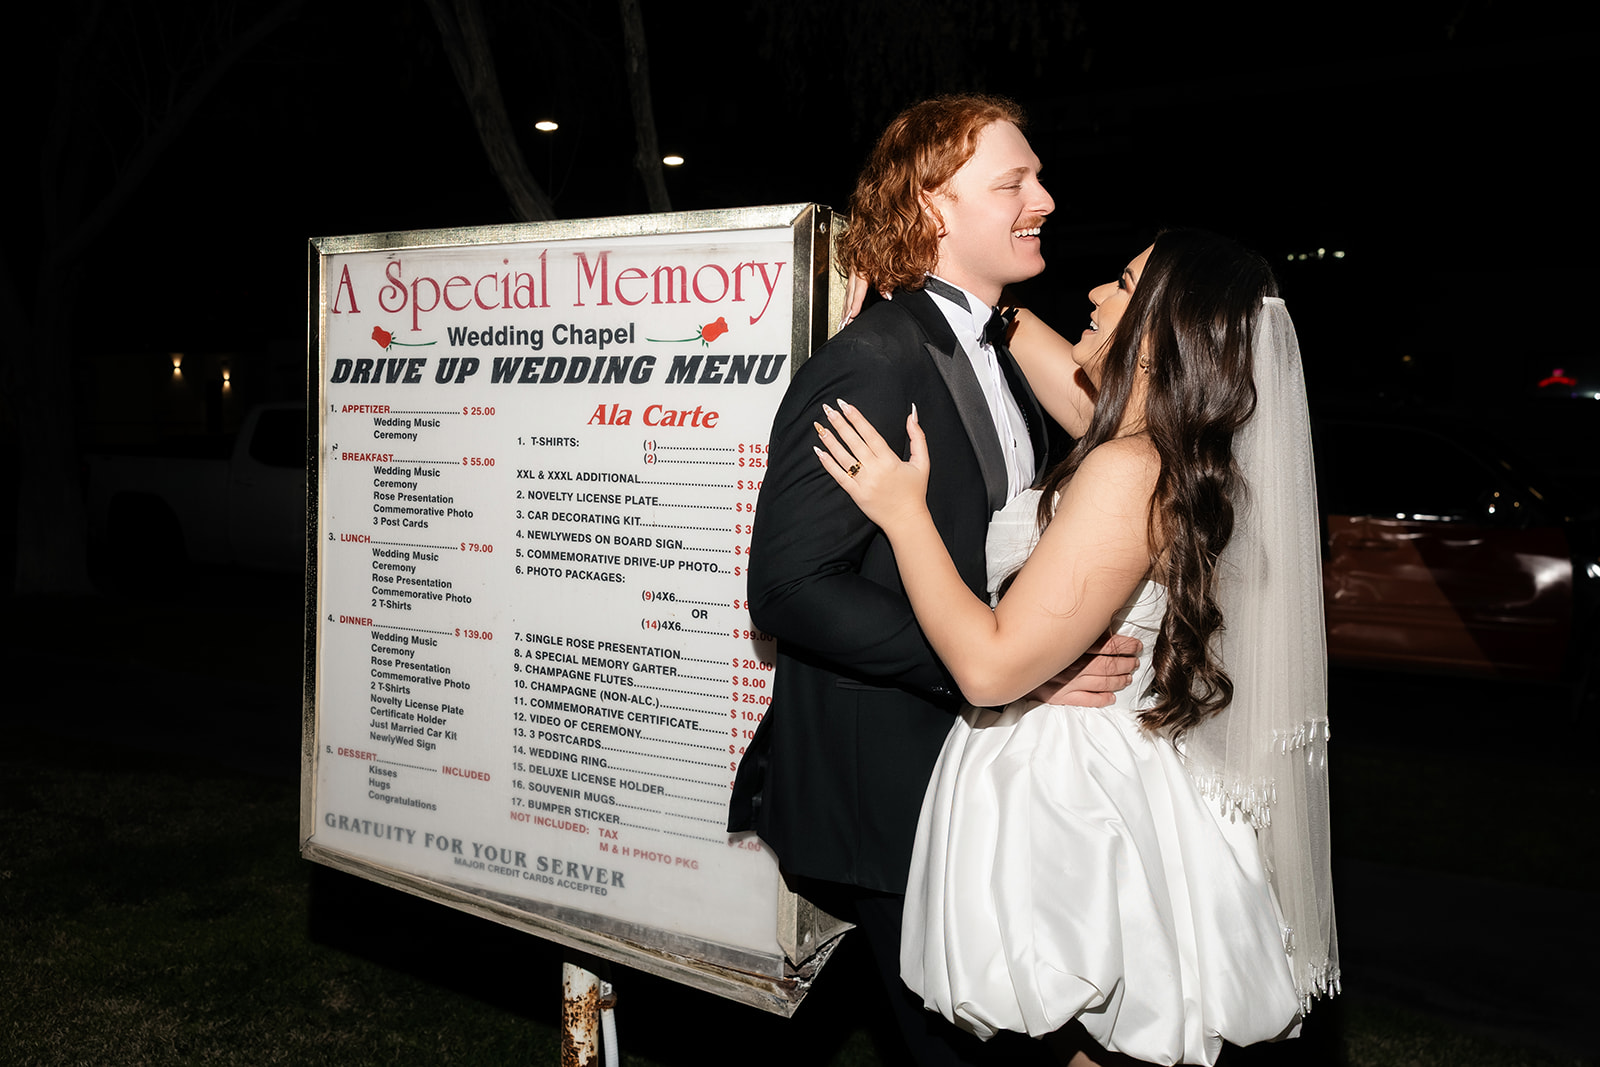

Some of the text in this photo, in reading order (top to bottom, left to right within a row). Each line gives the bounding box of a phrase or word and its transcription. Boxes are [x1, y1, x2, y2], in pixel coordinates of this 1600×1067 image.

[331, 248, 787, 332] A Special Memory
[446, 323, 635, 351] Wedding Chapel
[330, 354, 788, 385] DRIVE UP WEDDING MENU
[330, 404, 337, 413] 1.
[341, 405, 390, 414] APPETIZER
[587, 404, 720, 429] Ala Carte
[373, 418, 440, 428] Wedding Music
[373, 430, 418, 442] Ceremony
[517, 437, 657, 451] 1. T-SHIRTS: (1)
[341, 452, 394, 463] BREAKFAST
[644, 453, 657, 465] (2)
[373, 466, 440, 478] Wedding Music
[516, 469, 640, 484] XXL XXXL ADDITIONAL
[373, 479, 418, 491] Ceremony
[373, 491, 454, 504] Rose Presentation
[516, 490, 659, 506] 2. NOVELTY LICENSE PLATE
[373, 504, 474, 518] Commemorative Photo
[516, 510, 641, 526] 3. CAR DECORATING KIT
[373, 517, 429, 528] 3 Post Cards
[328, 532, 336, 541] 3.
[340, 533, 371, 544] LUNCH
[516, 530, 683, 549] 4. NEWLYWEDS ON BOARD SIGN
[372, 548, 439, 562] Wedding Music
[515, 548, 718, 573] 5. COMMEMORATIVE DRIVE-UP PHOTO
[372, 561, 416, 574] Ceremony
[515, 565, 626, 583] 6. PHOTO PACKAGES:
[372, 573, 452, 588] Rose Presentation
[372, 586, 472, 604] Commemorative Photo
[371, 599, 412, 611] 2 T-Shirts
[691, 609, 708, 619] OR
[327, 614, 335, 623] 4.
[339, 615, 373, 627] DINNER
[371, 630, 438, 647] Wedding Music
[514, 632, 523, 642] 7.
[525, 633, 563, 646] SINGLE
[566, 637, 595, 650] ROSE
[598, 641, 681, 660] PRESENTATION
[371, 643, 415, 658] Ceremony
[370, 656, 451, 674] Rose Presentation
[514, 648, 523, 658] 8.
[525, 649, 532, 659] A
[535, 650, 579, 665] SPECIAL
[581, 656, 630, 671] MEMORY
[632, 662, 677, 677] GARTER
[370, 669, 470, 690] Commemorative Photo
[513, 663, 522, 672] 9.
[525, 664, 591, 681] CHAMPAGNE
[594, 673, 634, 687] FLUTES
[370, 682, 411, 695] 2 T-Shirts
[514, 679, 660, 709] 10. CHAMPAGNE (NON-ALC.)
[370, 693, 464, 715] Novelty License Plate
[370, 706, 447, 726] Certificate Holder
[530, 697, 699, 731] COMMEMORATIVE CERTIFICATE
[370, 719, 457, 741] Just Married Car Kit
[529, 713, 642, 739] VIDEO OF CEREMONY
[370, 731, 436, 752] NewlyWed Sign
[529, 729, 601, 749] 3 POSTCARDS
[326, 745, 491, 782] 5. DESSERT INCLUDED
[529, 747, 607, 768] WEDDING RING
[368, 765, 397, 778] Kisses
[529, 764, 665, 795] DELUXE LICENSE HOLDER
[368, 778, 391, 790] Hugs
[368, 790, 437, 811] Congratulations
[528, 781, 616, 806] SOUVENIR MUGS
[528, 799, 572, 816] BUMPER
[574, 808, 620, 824] STICKER
[510, 811, 619, 840] NOT INCLUDED: TAX
[324, 812, 625, 889] GRATUITY FOR YOUR SERVER
[599, 842, 699, 870] M H PHOTO PKG
[454, 856, 608, 897] MAJOR CREDIT CARDS ACCEPTED
